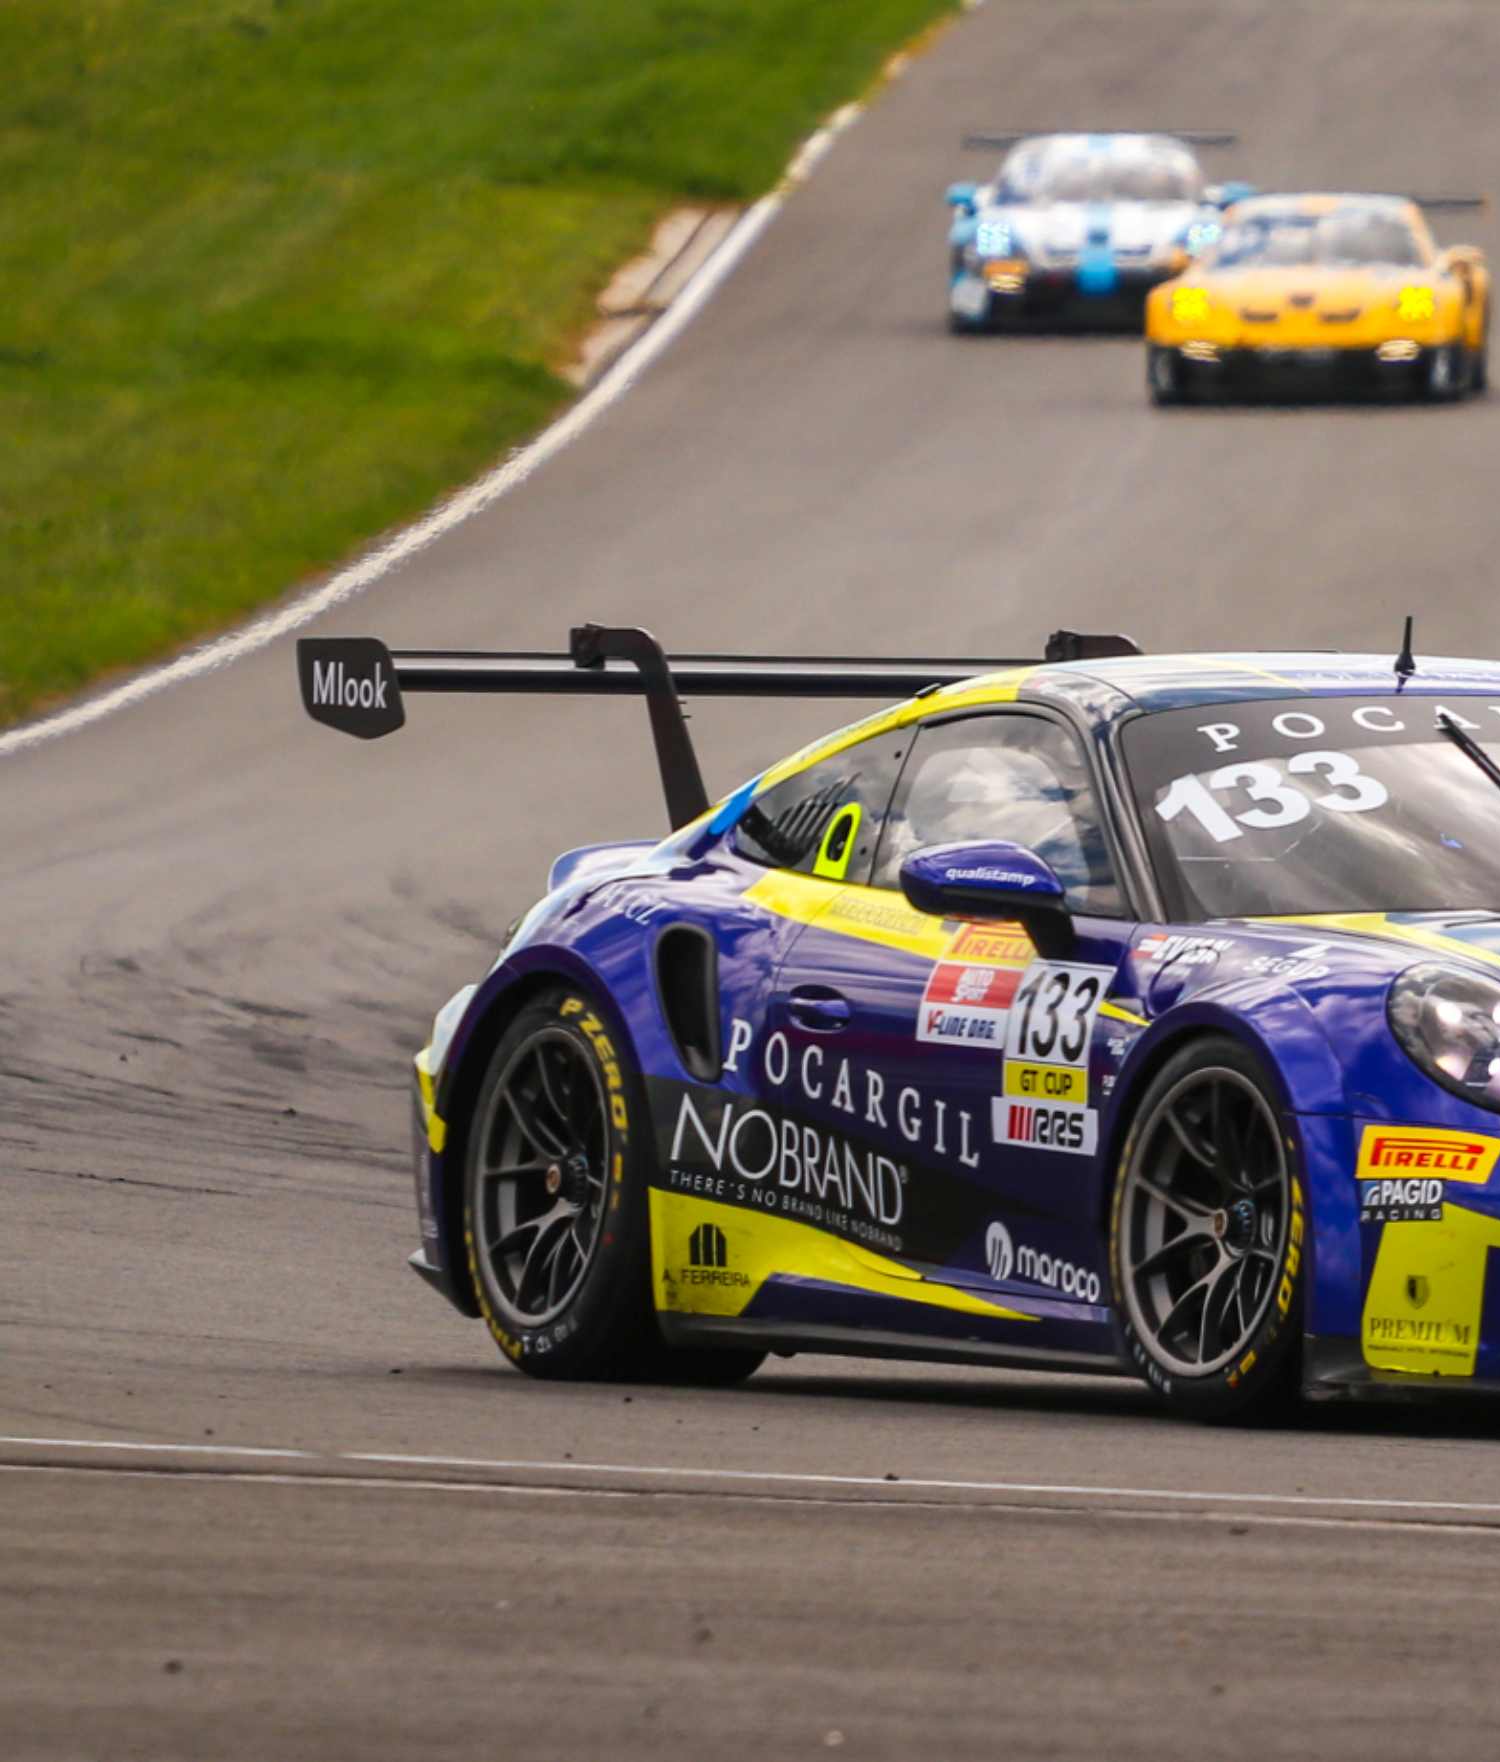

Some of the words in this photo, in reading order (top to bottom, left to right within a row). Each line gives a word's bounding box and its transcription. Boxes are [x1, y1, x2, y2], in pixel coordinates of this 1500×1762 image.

[312, 660, 388, 709] Mlook
[1155, 750, 1389, 843] 133
[944, 867, 1036, 887] qualistamp
[1017, 970, 1099, 1062] 133
[722, 1018, 979, 1168] POCARGIL
[1020, 1069, 1039, 1091] GT
[1044, 1072, 1073, 1095] CUP
[1031, 1108, 1084, 1148] RRS
[670, 1092, 903, 1225] NOBRAND
[1369, 1137, 1485, 1171] PIRELLI
[1380, 1179, 1443, 1206] PAGID
[751, 1188, 777, 1208] NO
[782, 1196, 822, 1221] BRAND
[826, 1210, 848, 1231] LIKE
[851, 1221, 904, 1252] NOBRAND
[1360, 1208, 1442, 1222] RACING
[681, 1269, 751, 1288] FERREIRA
[1017, 1245, 1100, 1303] maroco
[1369, 1317, 1471, 1346] PREMIUM
